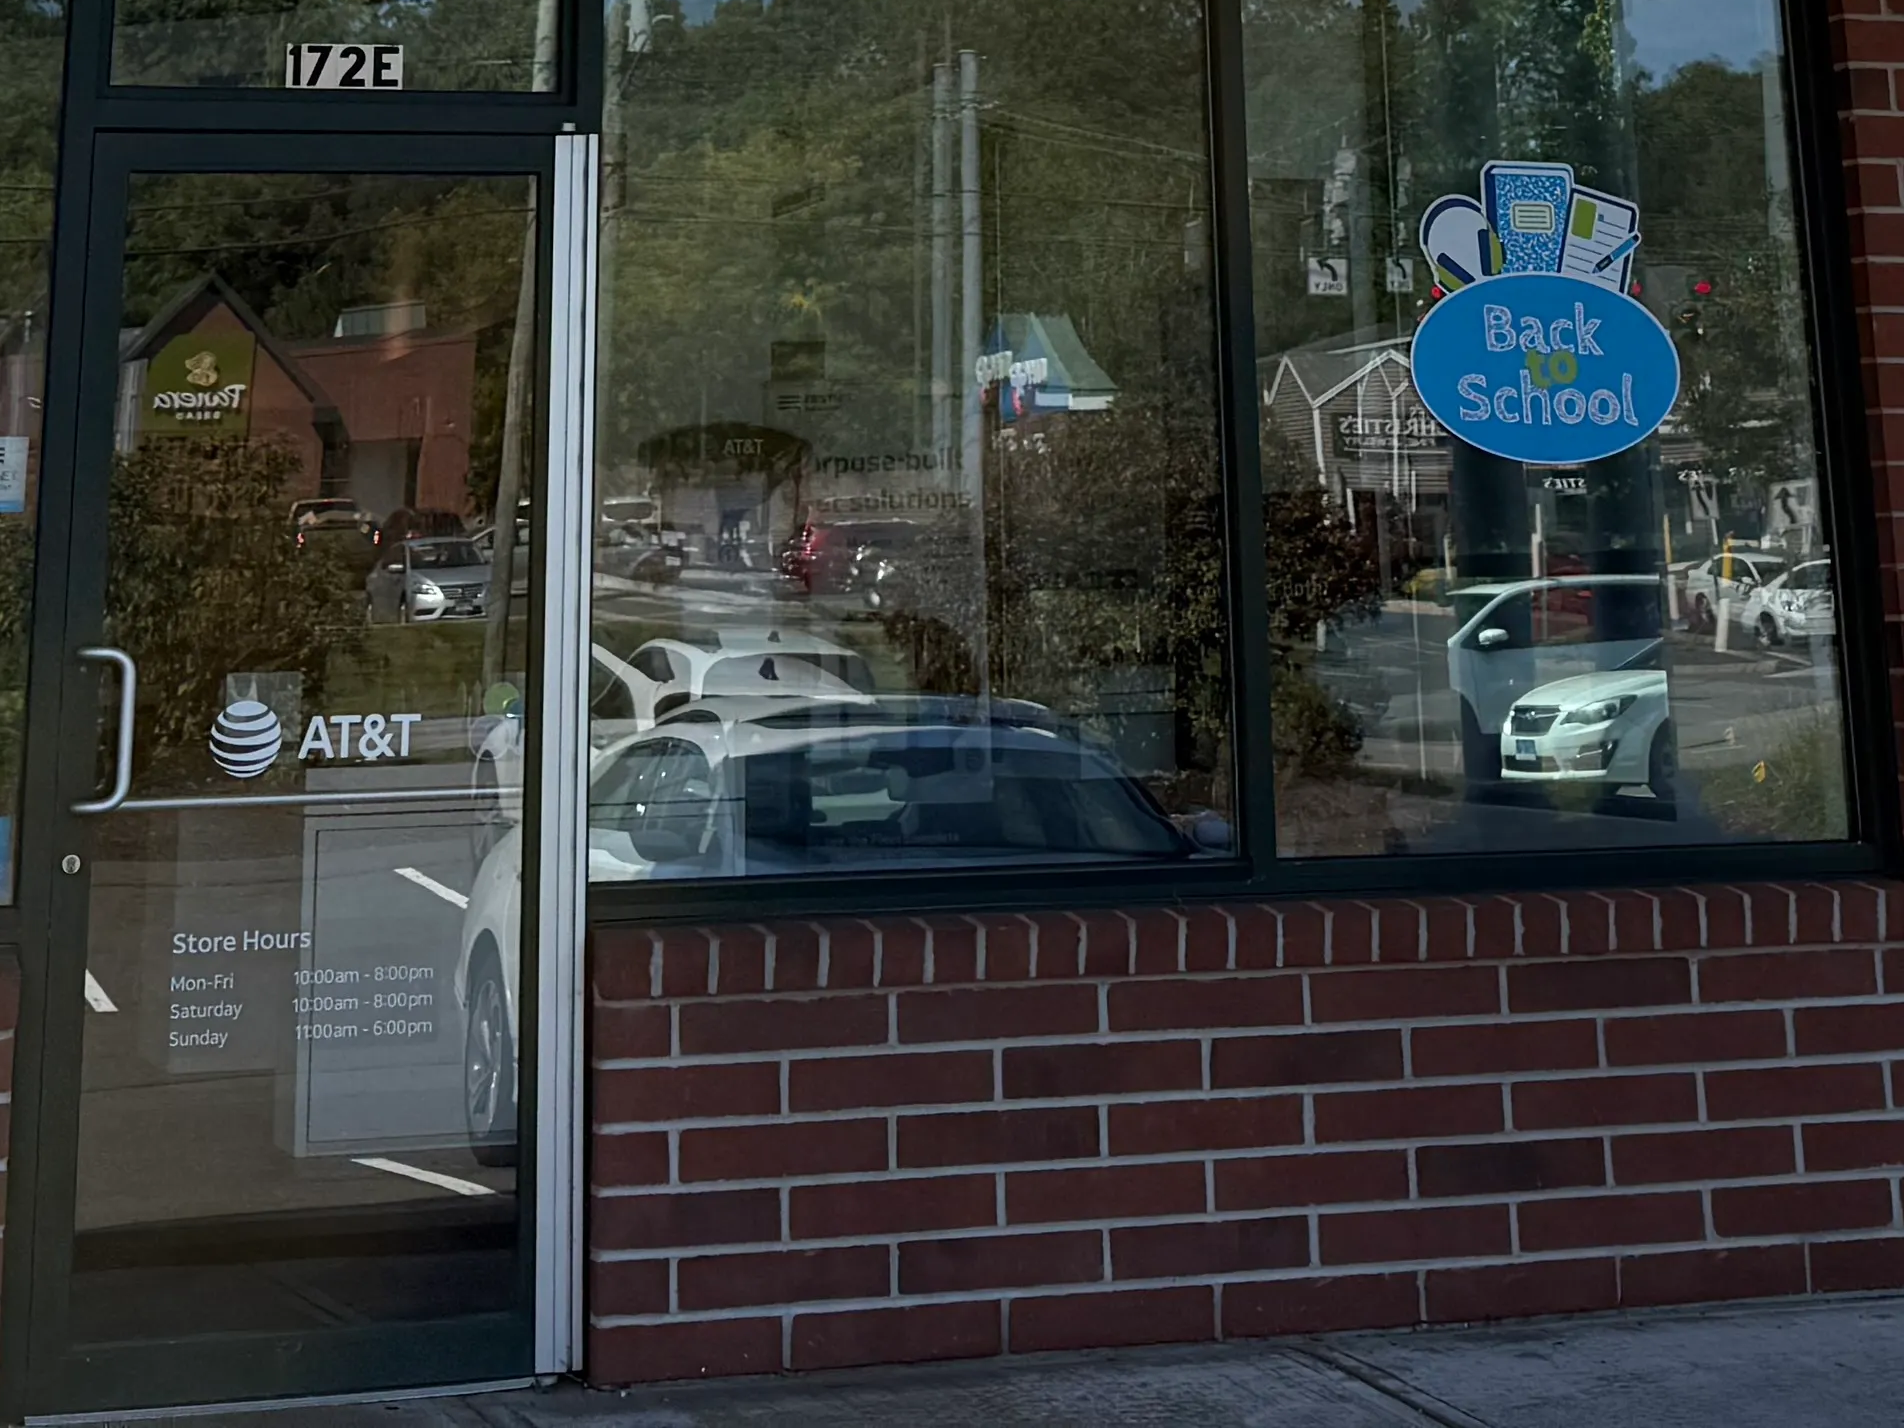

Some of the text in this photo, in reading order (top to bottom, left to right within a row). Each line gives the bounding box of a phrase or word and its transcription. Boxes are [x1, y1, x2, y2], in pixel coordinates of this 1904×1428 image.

[289, 45, 400, 87] 172E
[1483, 301, 1604, 355] Back
[1525, 349, 1578, 389] to
[1457, 369, 1639, 427] School
[722, 439, 764, 456] AT&T
[298, 713, 421, 760] AT&T
[172, 930, 312, 954] Store Hours
[170, 972, 234, 992] Mon-Fri
[294, 968, 360, 985] 10:00am
[374, 965, 434, 984] 8:00pm
[170, 1000, 243, 1020] Saturday
[292, 995, 359, 1013] 10:00am
[373, 992, 433, 1012] 8:00pm
[169, 1028, 228, 1048] Sunday
[295, 1022, 358, 1040] 11:00am
[372, 1019, 433, 1040] 6:00pm
